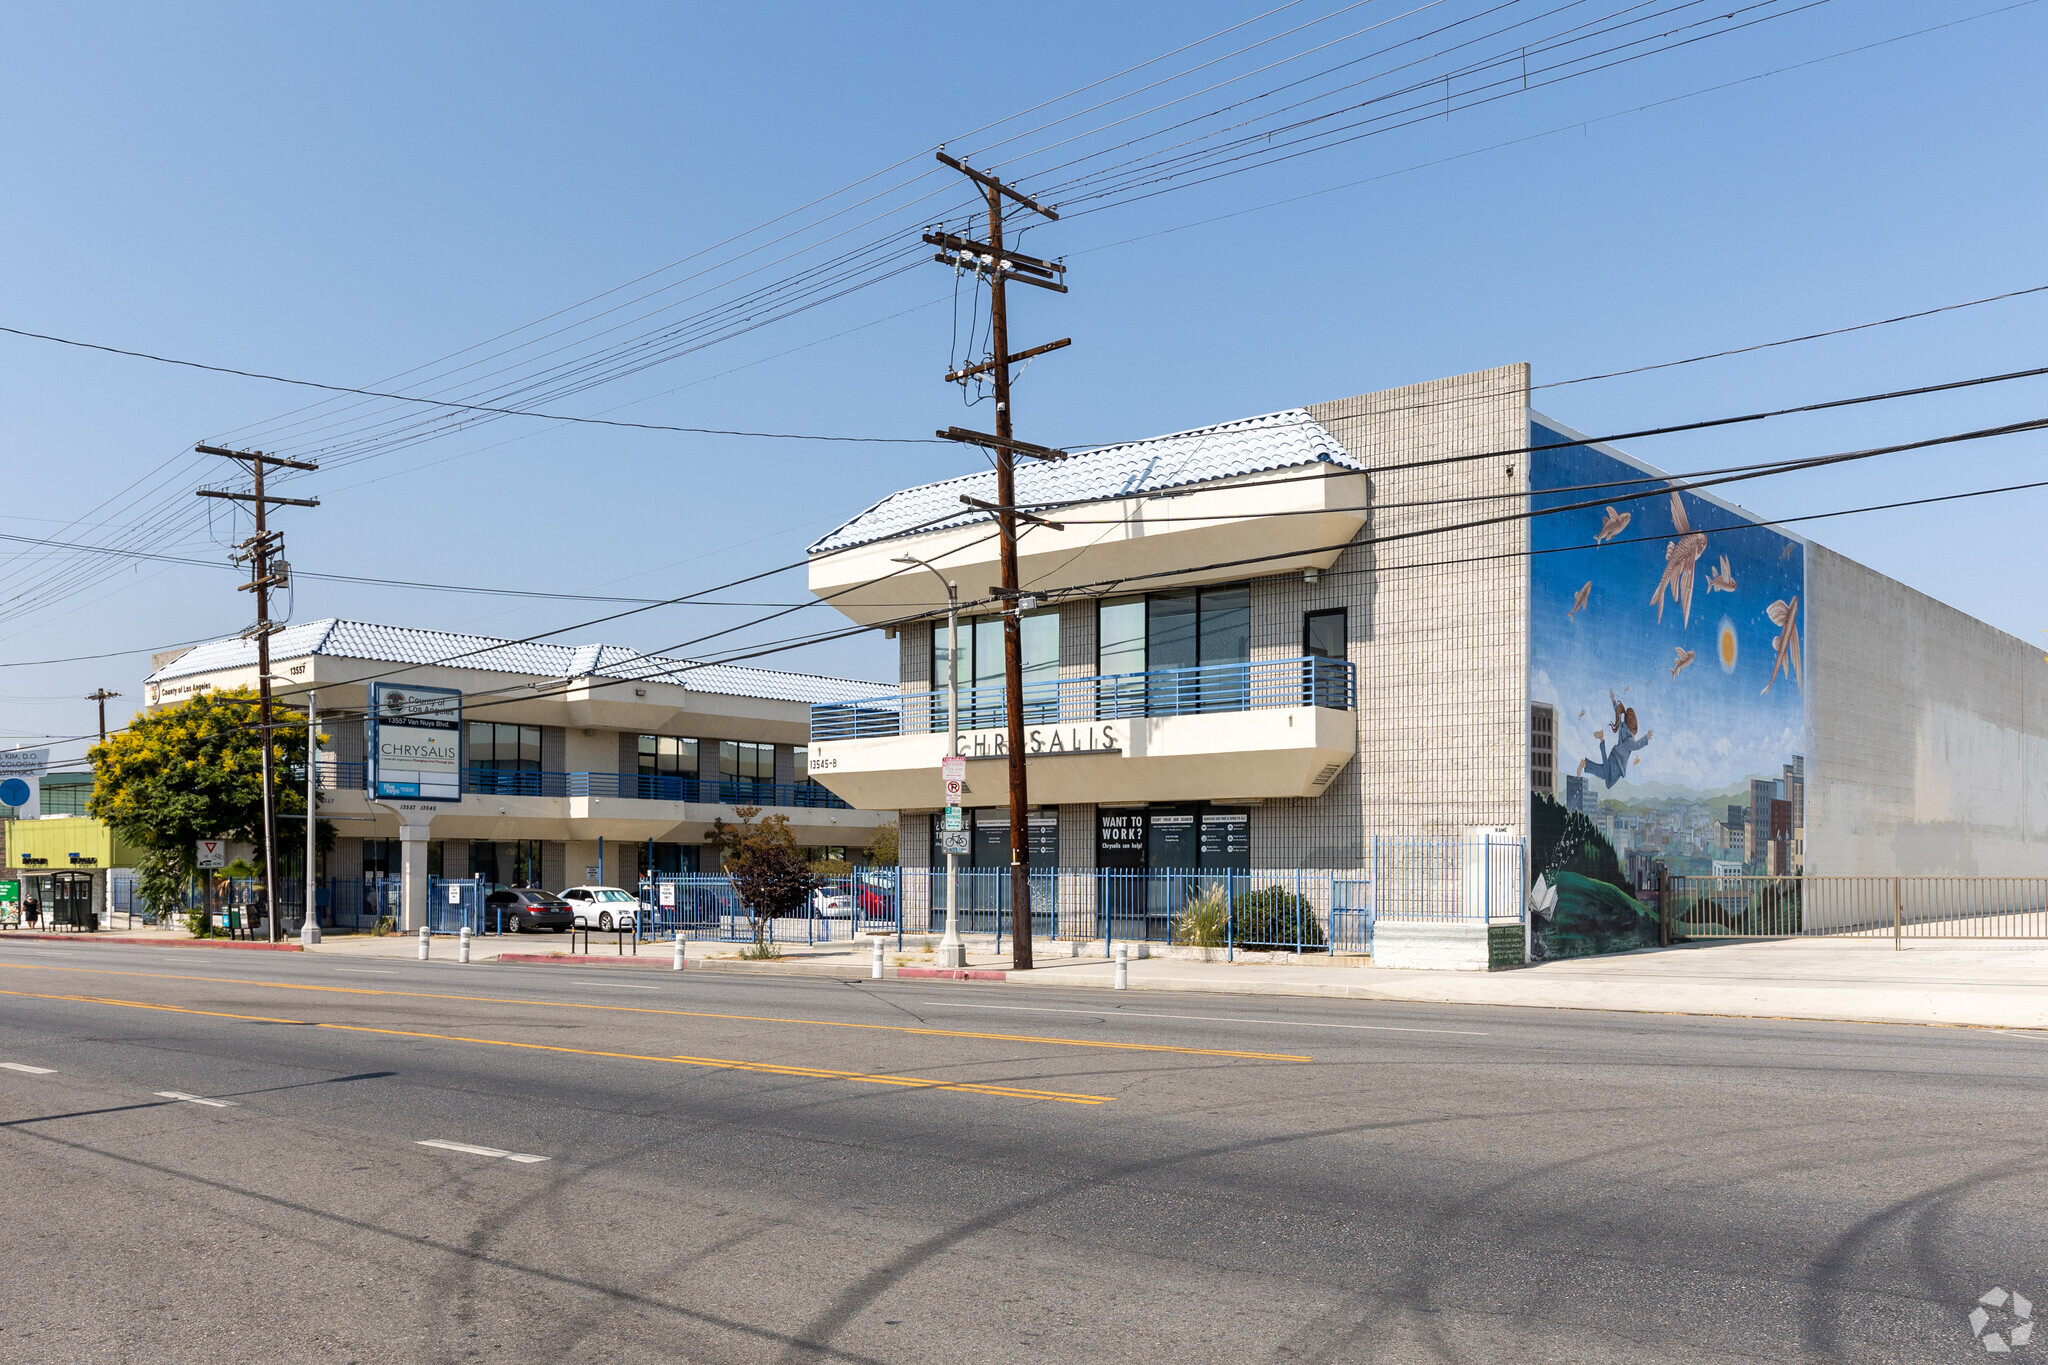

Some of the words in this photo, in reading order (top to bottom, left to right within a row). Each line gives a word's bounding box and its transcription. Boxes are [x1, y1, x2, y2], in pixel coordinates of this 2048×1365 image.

[290, 665, 306, 675] 13557
[161, 687, 177, 696] County
[183, 685, 191, 693] Los
[192, 682, 211, 692] Angeles
[408, 695, 436, 707] County
[408, 705, 422, 713] Los
[424, 706, 454, 716] Angeles
[956, 725, 1114, 758] CHRSALIS
[381, 743, 455, 758] CHRYSALIS
[810, 759, 837, 769] 13545-B
[1102, 816, 1128, 828] WANT
[1131, 816, 1142, 828] TO
[1102, 828, 1142, 840] WORK?
[1102, 842, 1121, 850] Chrysalis
[1131, 842, 1142, 850] help!
